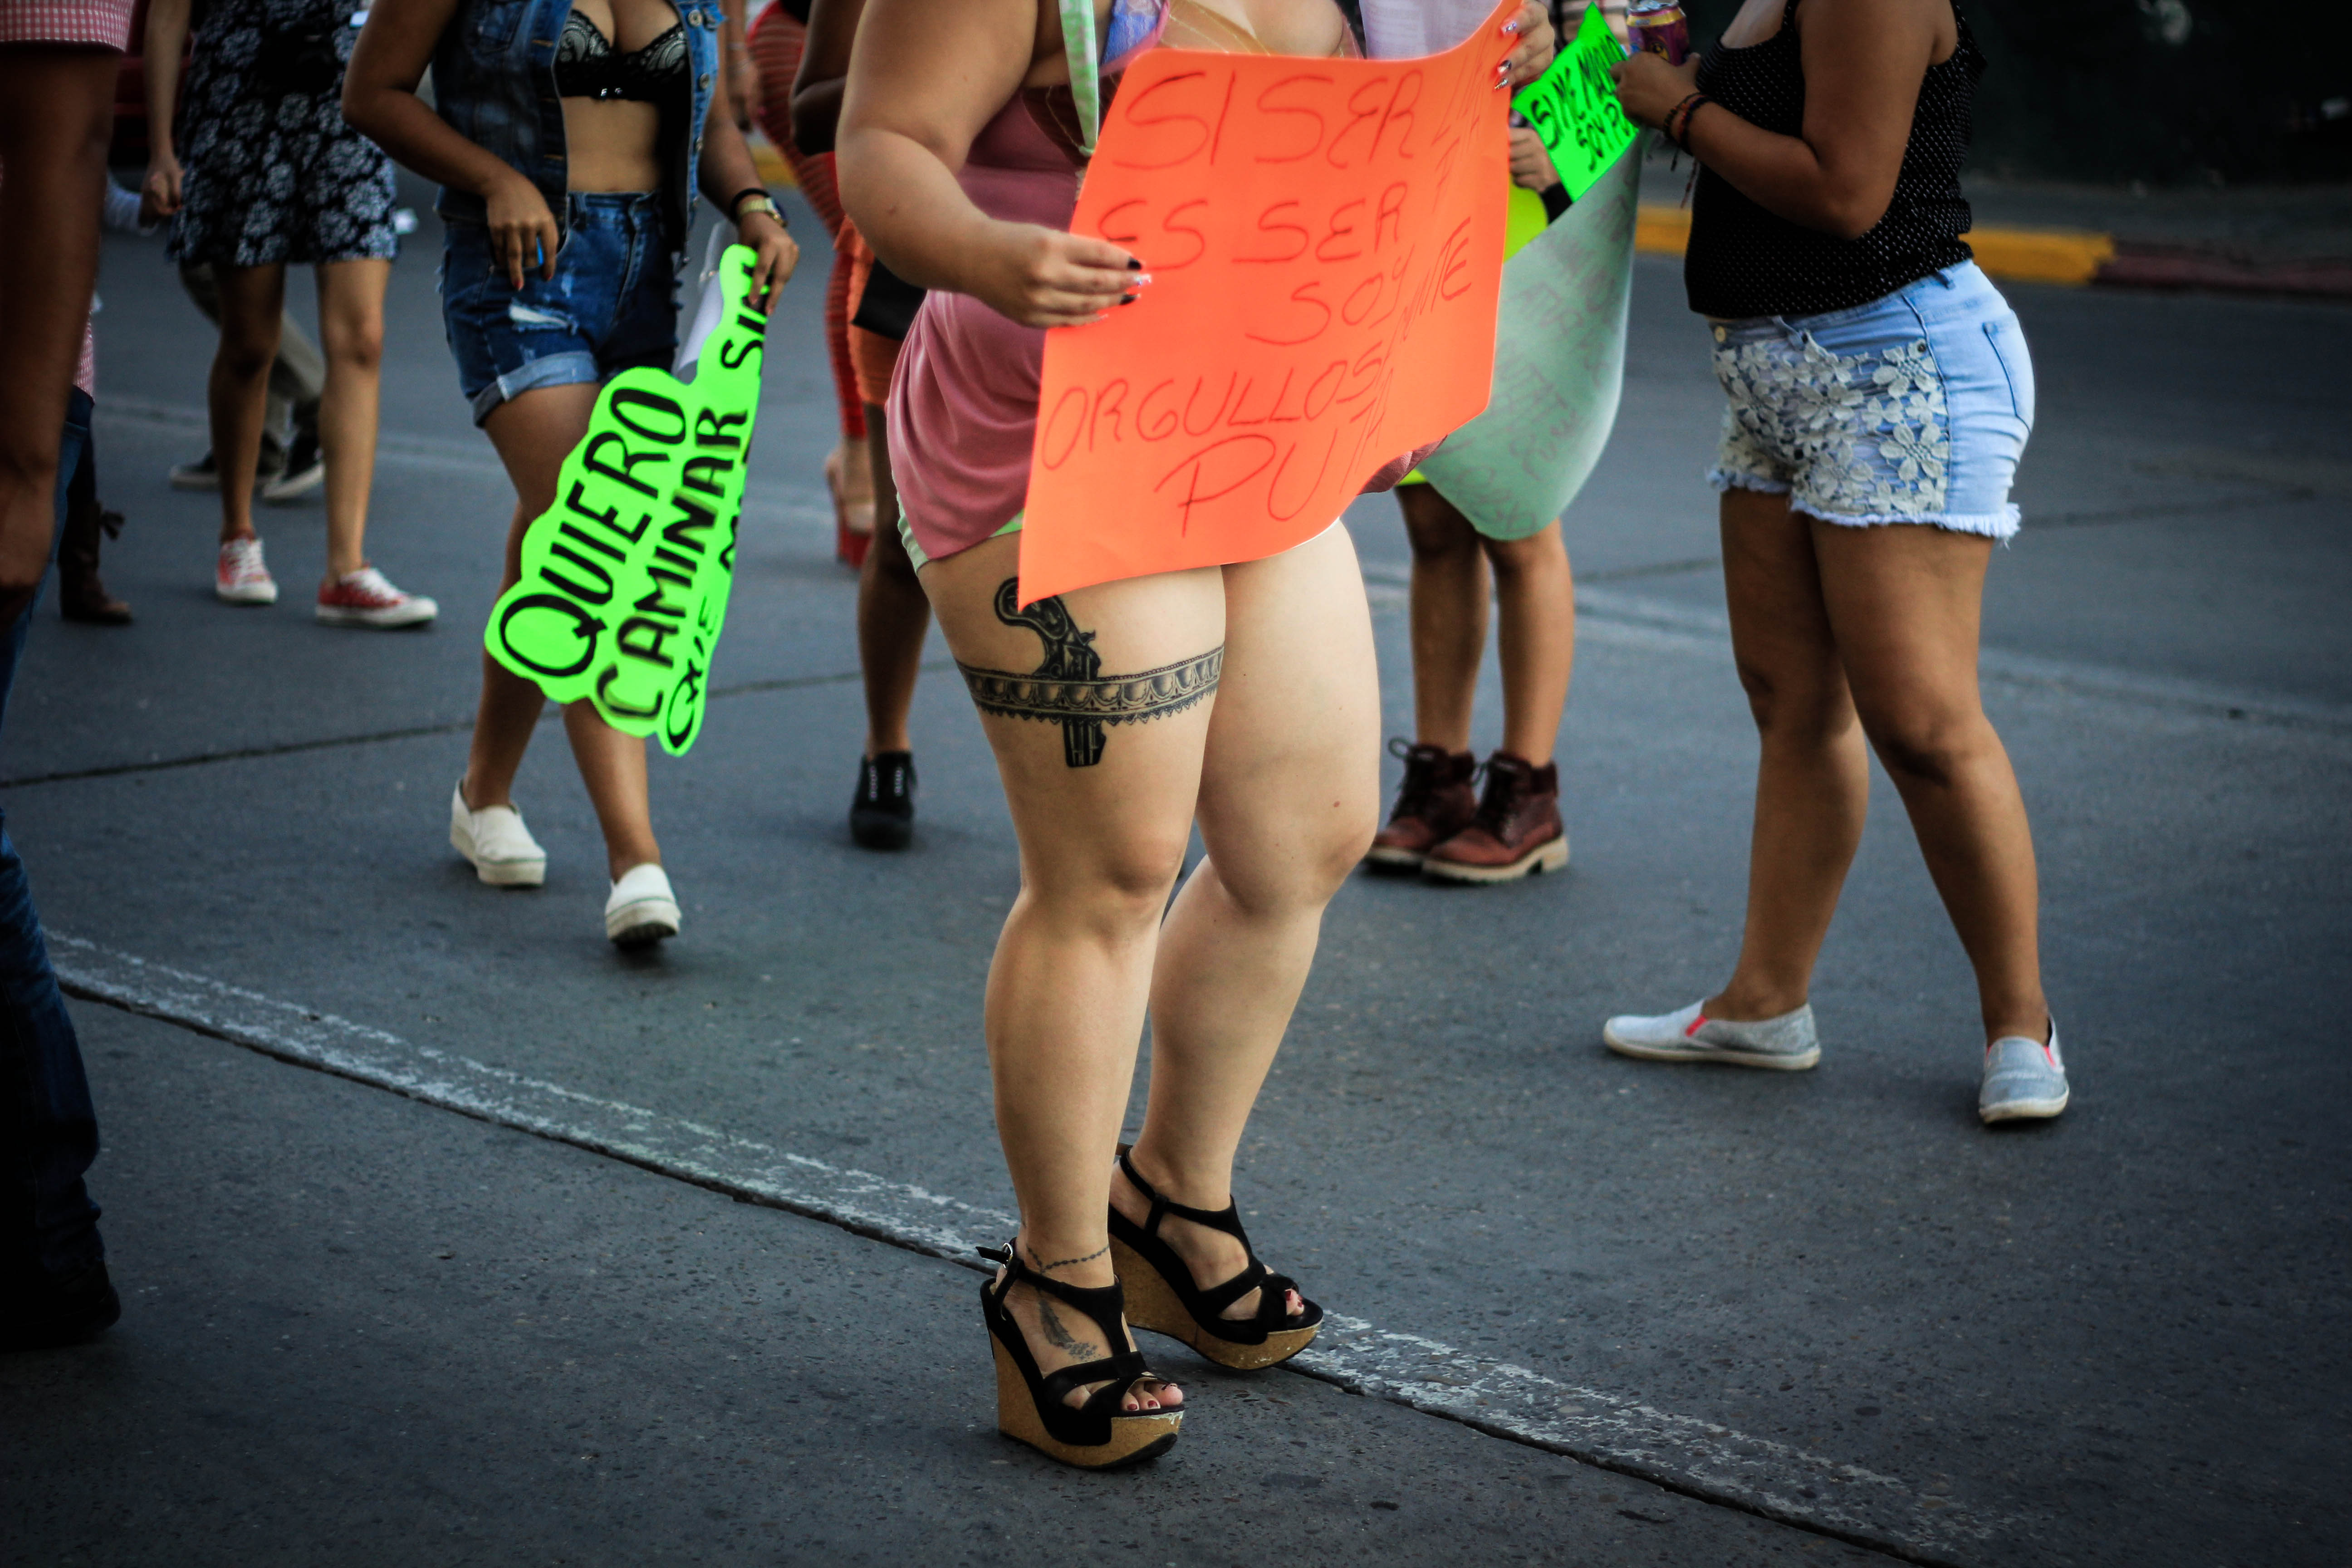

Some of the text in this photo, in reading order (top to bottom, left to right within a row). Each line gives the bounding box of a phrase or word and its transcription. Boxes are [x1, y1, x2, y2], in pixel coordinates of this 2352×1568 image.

[1112, 69, 1237, 170] SI
[1253, 69, 1424, 170] SER
[1230, 181, 1409, 265] SER
[1244, 243, 1416, 347] SOY
[499, 387, 687, 677] QUIERO
[596, 406, 749, 721] CAMINAR
